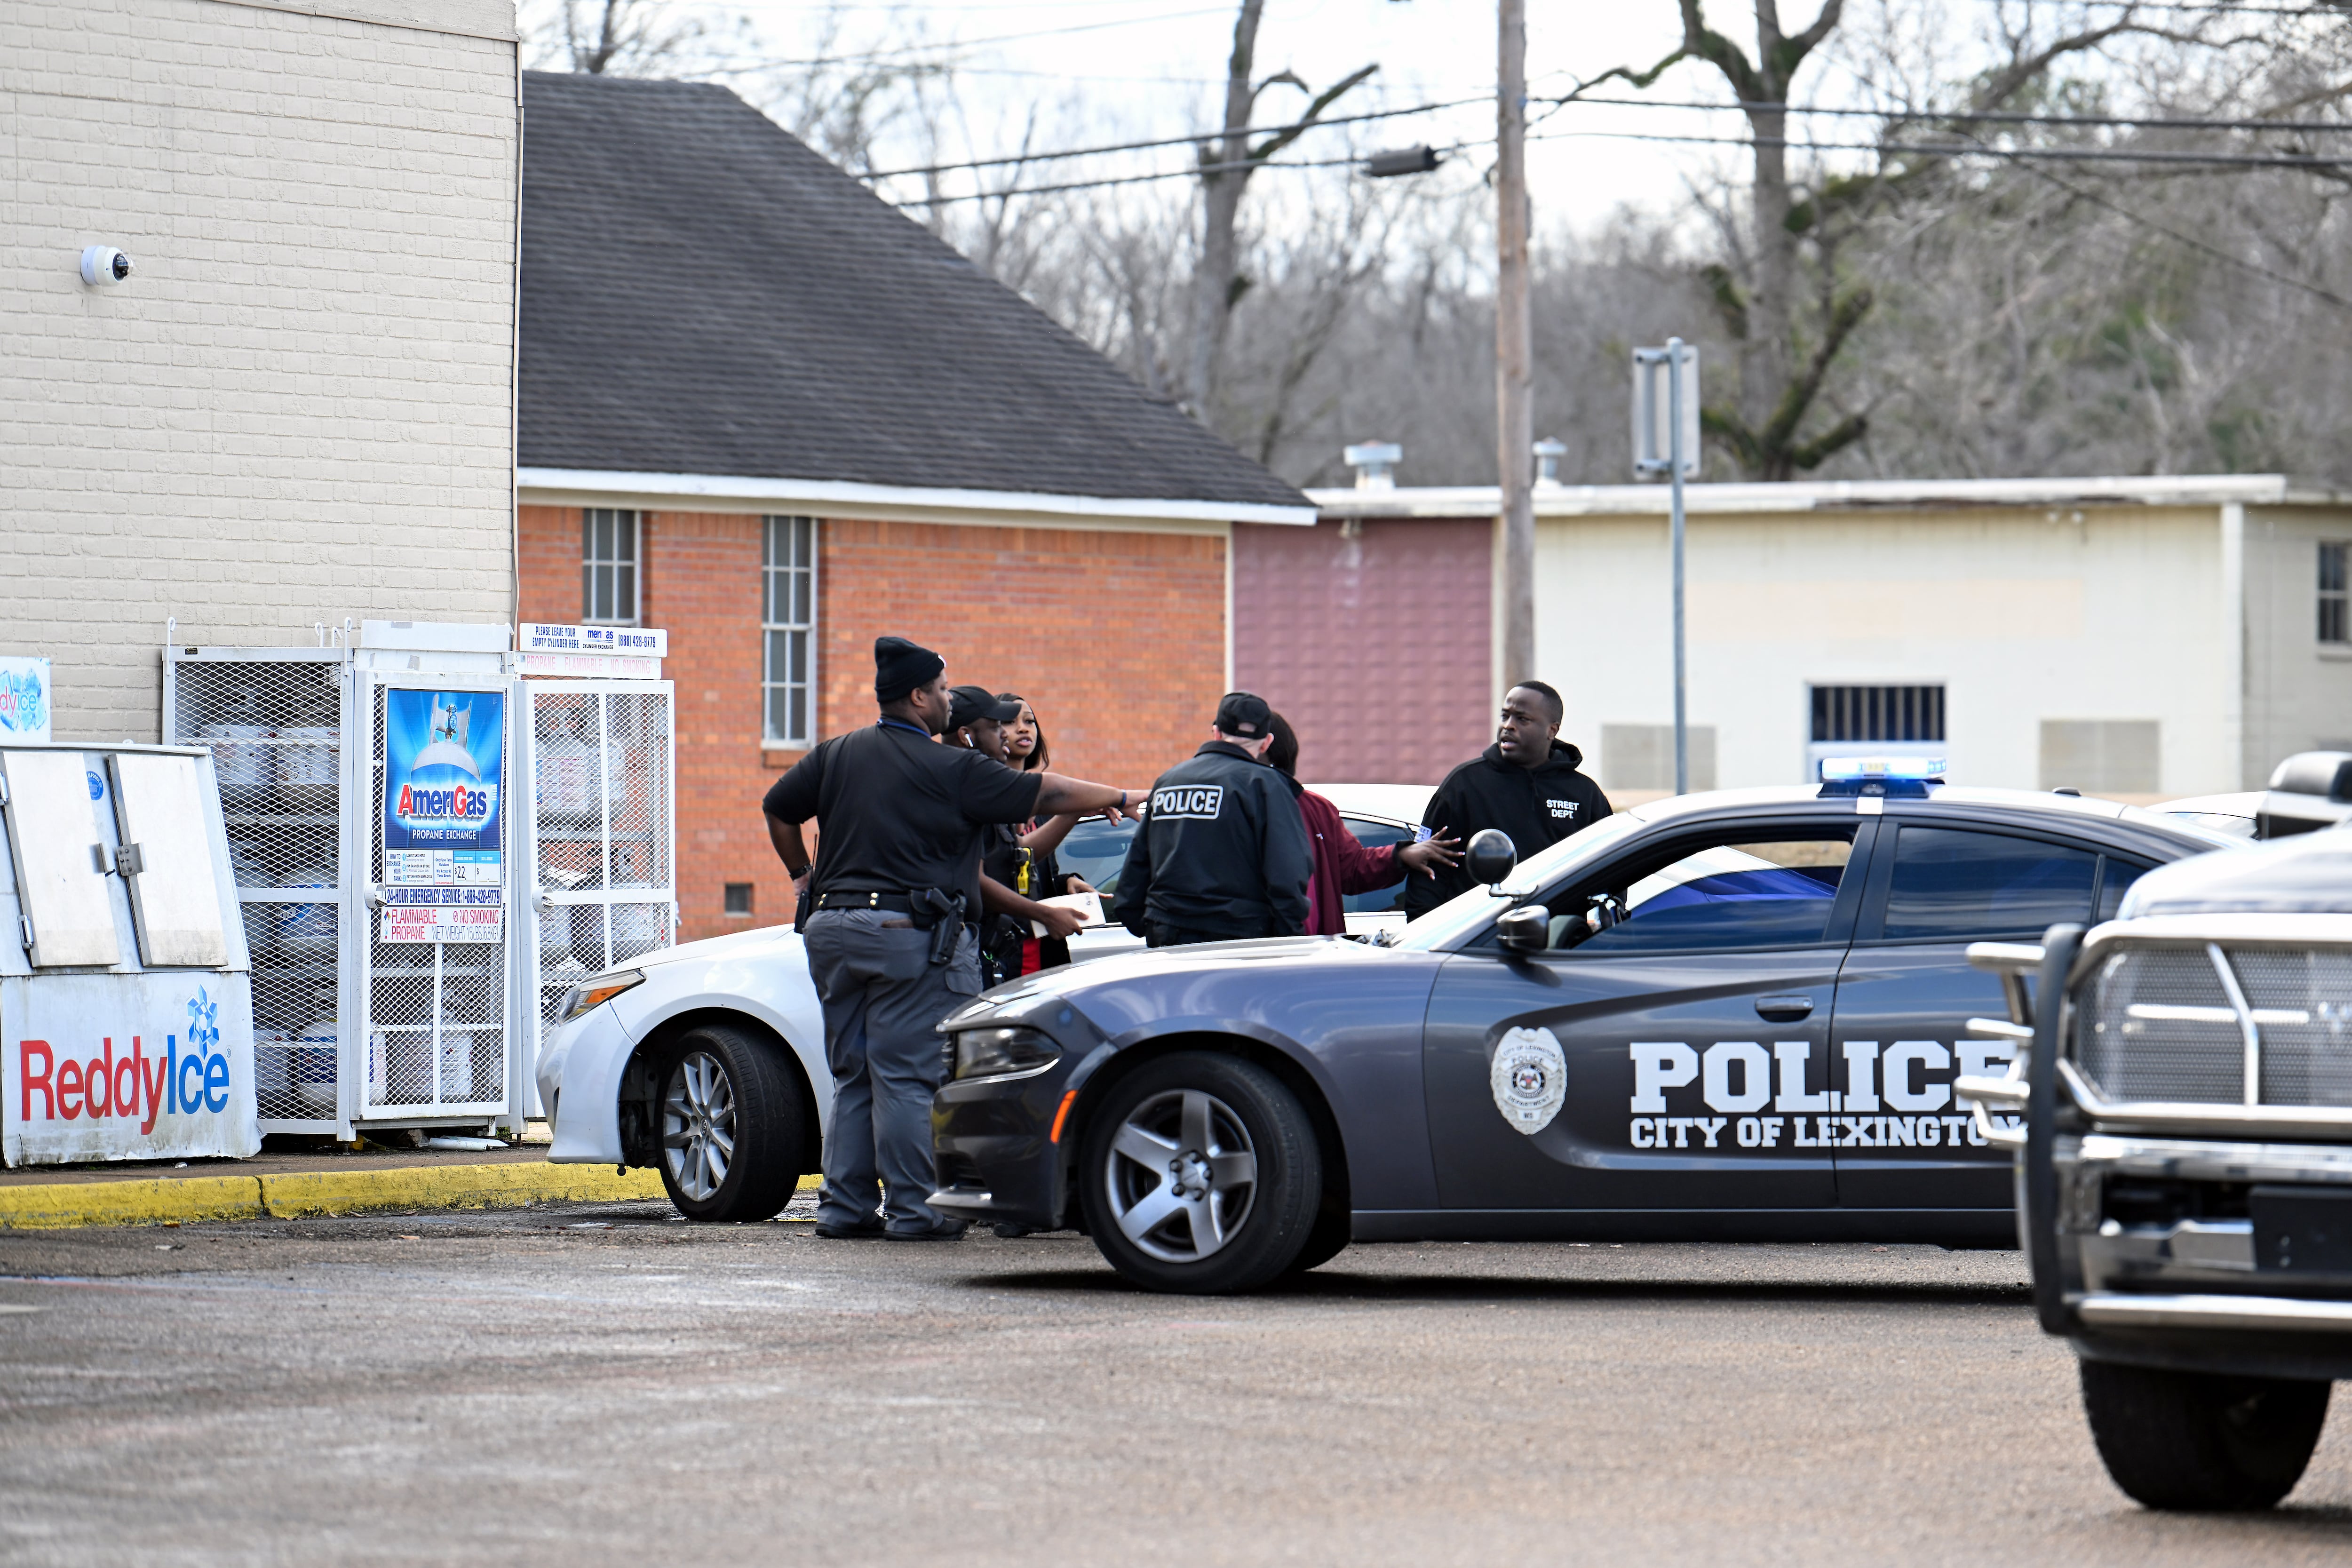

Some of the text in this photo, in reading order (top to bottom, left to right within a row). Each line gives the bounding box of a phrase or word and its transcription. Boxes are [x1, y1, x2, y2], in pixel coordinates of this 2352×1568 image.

[536, 626, 575, 637] PLEASE LEAVE YOUR
[532, 637, 579, 648] EMPTY CYLINDER HERE
[619, 634, 656, 647] (888) 428-9779
[527, 655, 651, 674] PROPANE FLAMMABLE NO SMOKING
[397, 784, 487, 817] AmeriGas
[1153, 790, 1219, 814] POLICE
[1546, 799, 1580, 811] STREET
[1551, 808, 1574, 819] DEPT.
[412, 829, 477, 840] PROPANE EXCHANGE
[387, 888, 408, 903] 24-HOUR
[410, 888, 440, 903] EMERGENCY
[392, 909, 499, 924] FLAMMABLE NO SMOKING
[391, 925, 426, 940] PROPANE
[432, 926, 445, 940] NET
[445, 926, 466, 940] WEIGHT
[1630, 1041, 2021, 1113] POLICE
[20, 1035, 230, 1135] ReddyIce
[1630, 1117, 1727, 1148] CITY
[1736, 1117, 1784, 1148] OF
